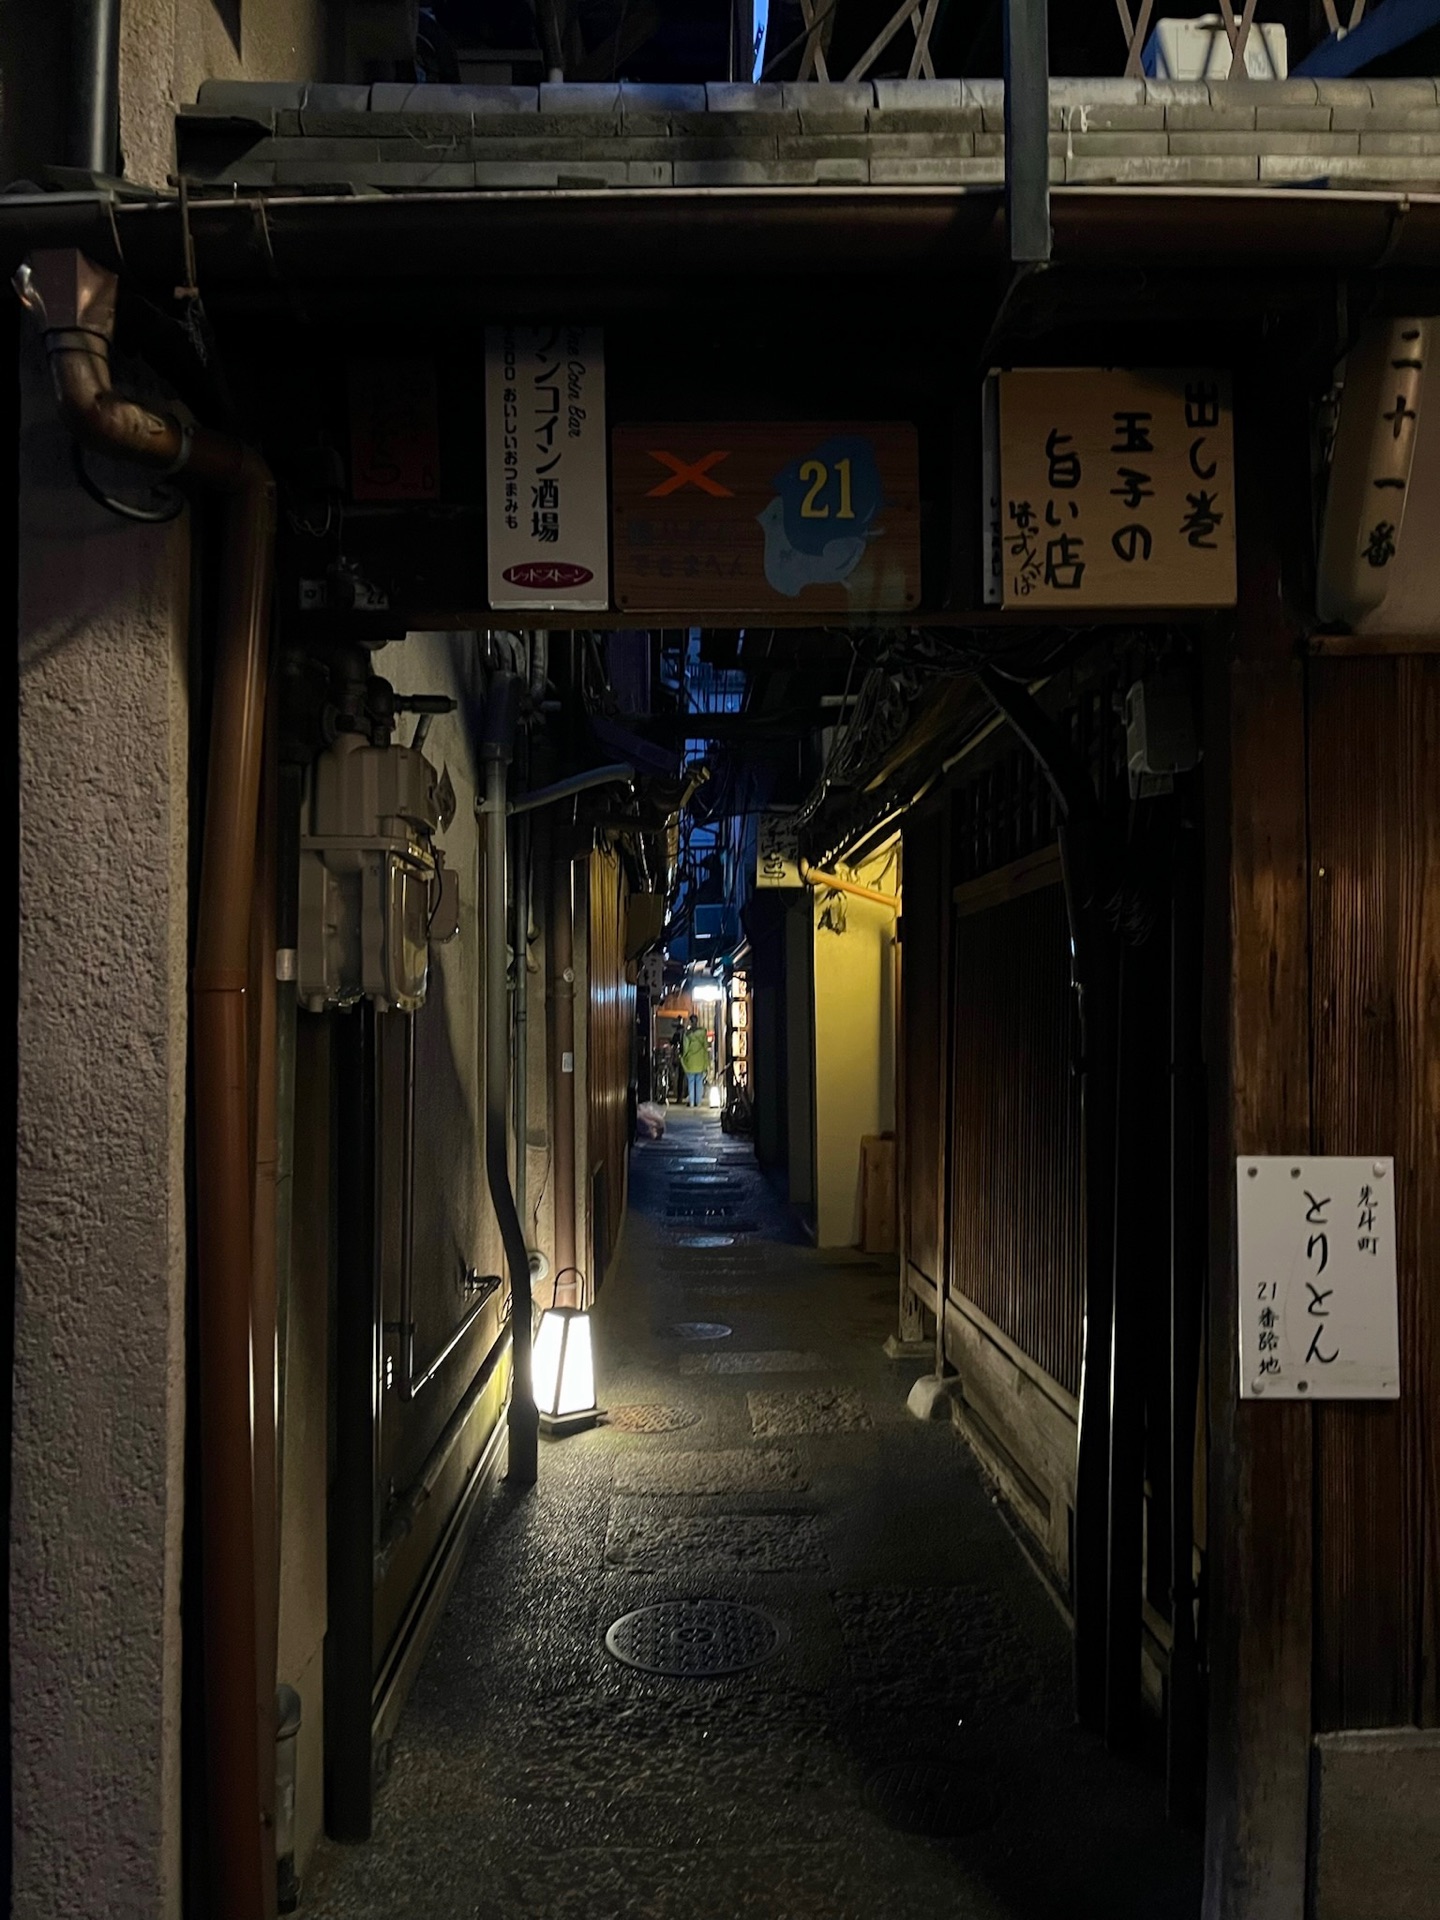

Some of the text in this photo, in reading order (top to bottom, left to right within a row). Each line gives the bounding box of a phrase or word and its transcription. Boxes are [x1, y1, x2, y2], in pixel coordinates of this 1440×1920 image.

[567, 361, 586, 402] Coin
[567, 405, 586, 438] Bar
[503, 388, 518, 529] おいしいおつまみも
[798, 458, 856, 519] 21
[1110, 412, 1155, 561] 玉子の
[1180, 382, 1223, 549] 出し巻
[1361, 330, 1422, 567] 二十一番
[1043, 428, 1085, 589] 旨い店
[510, 568, 588, 583] レッドストーン
[1303, 1190, 1339, 1364] とりとん
[1357, 1184, 1379, 1255] 先斗町
[1257, 1282, 1281, 1376] 21番路地
